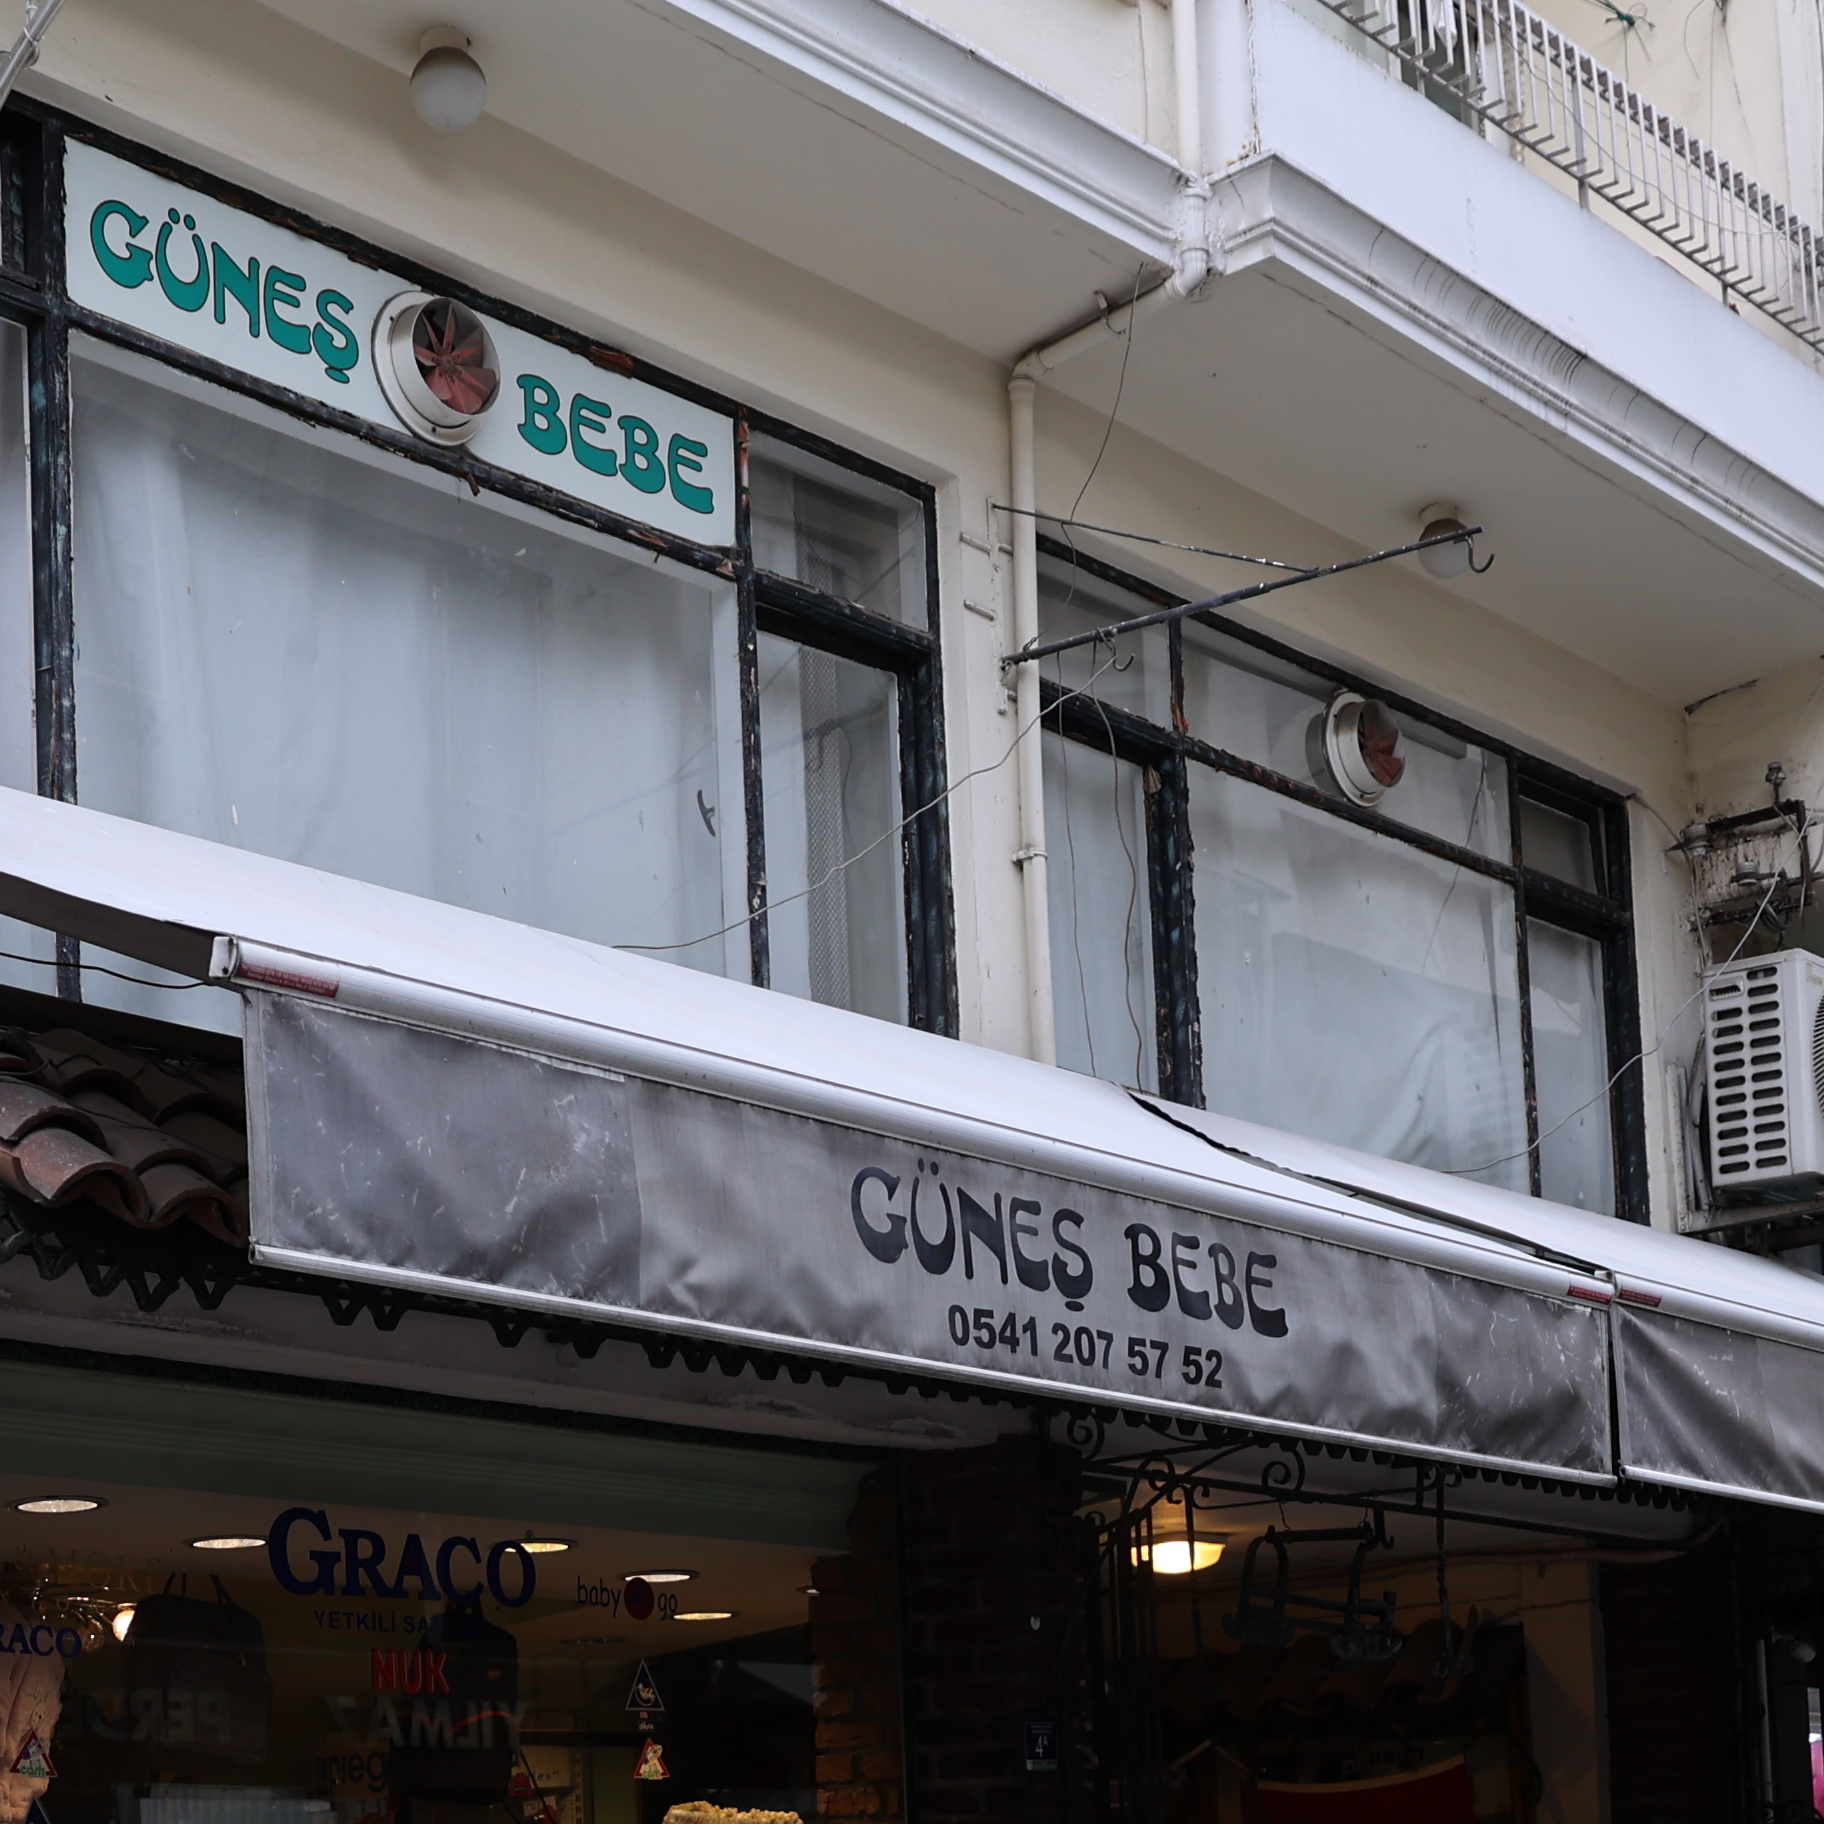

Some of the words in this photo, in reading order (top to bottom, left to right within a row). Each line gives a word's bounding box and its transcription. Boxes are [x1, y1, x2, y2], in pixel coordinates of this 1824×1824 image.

[90, 200, 359, 383] GÜNEŞ
[516, 374, 714, 514] BEBE
[851, 1158, 1094, 1312] GÜNEŞ
[1124, 1223, 1289, 1338] BEBE
[948, 1304, 1039, 1356] 0541
[1052, 1322, 1114, 1370] 207
[1127, 1338, 1169, 1379] 57
[1181, 1346, 1223, 1389] 52
[268, 1507, 536, 1608] GRACO
[577, 1575, 621, 1617] baby
[657, 1592, 678, 1622] go
[313, 1608, 397, 1635] YETKİLİ
[371, 1646, 450, 1695] NUK
